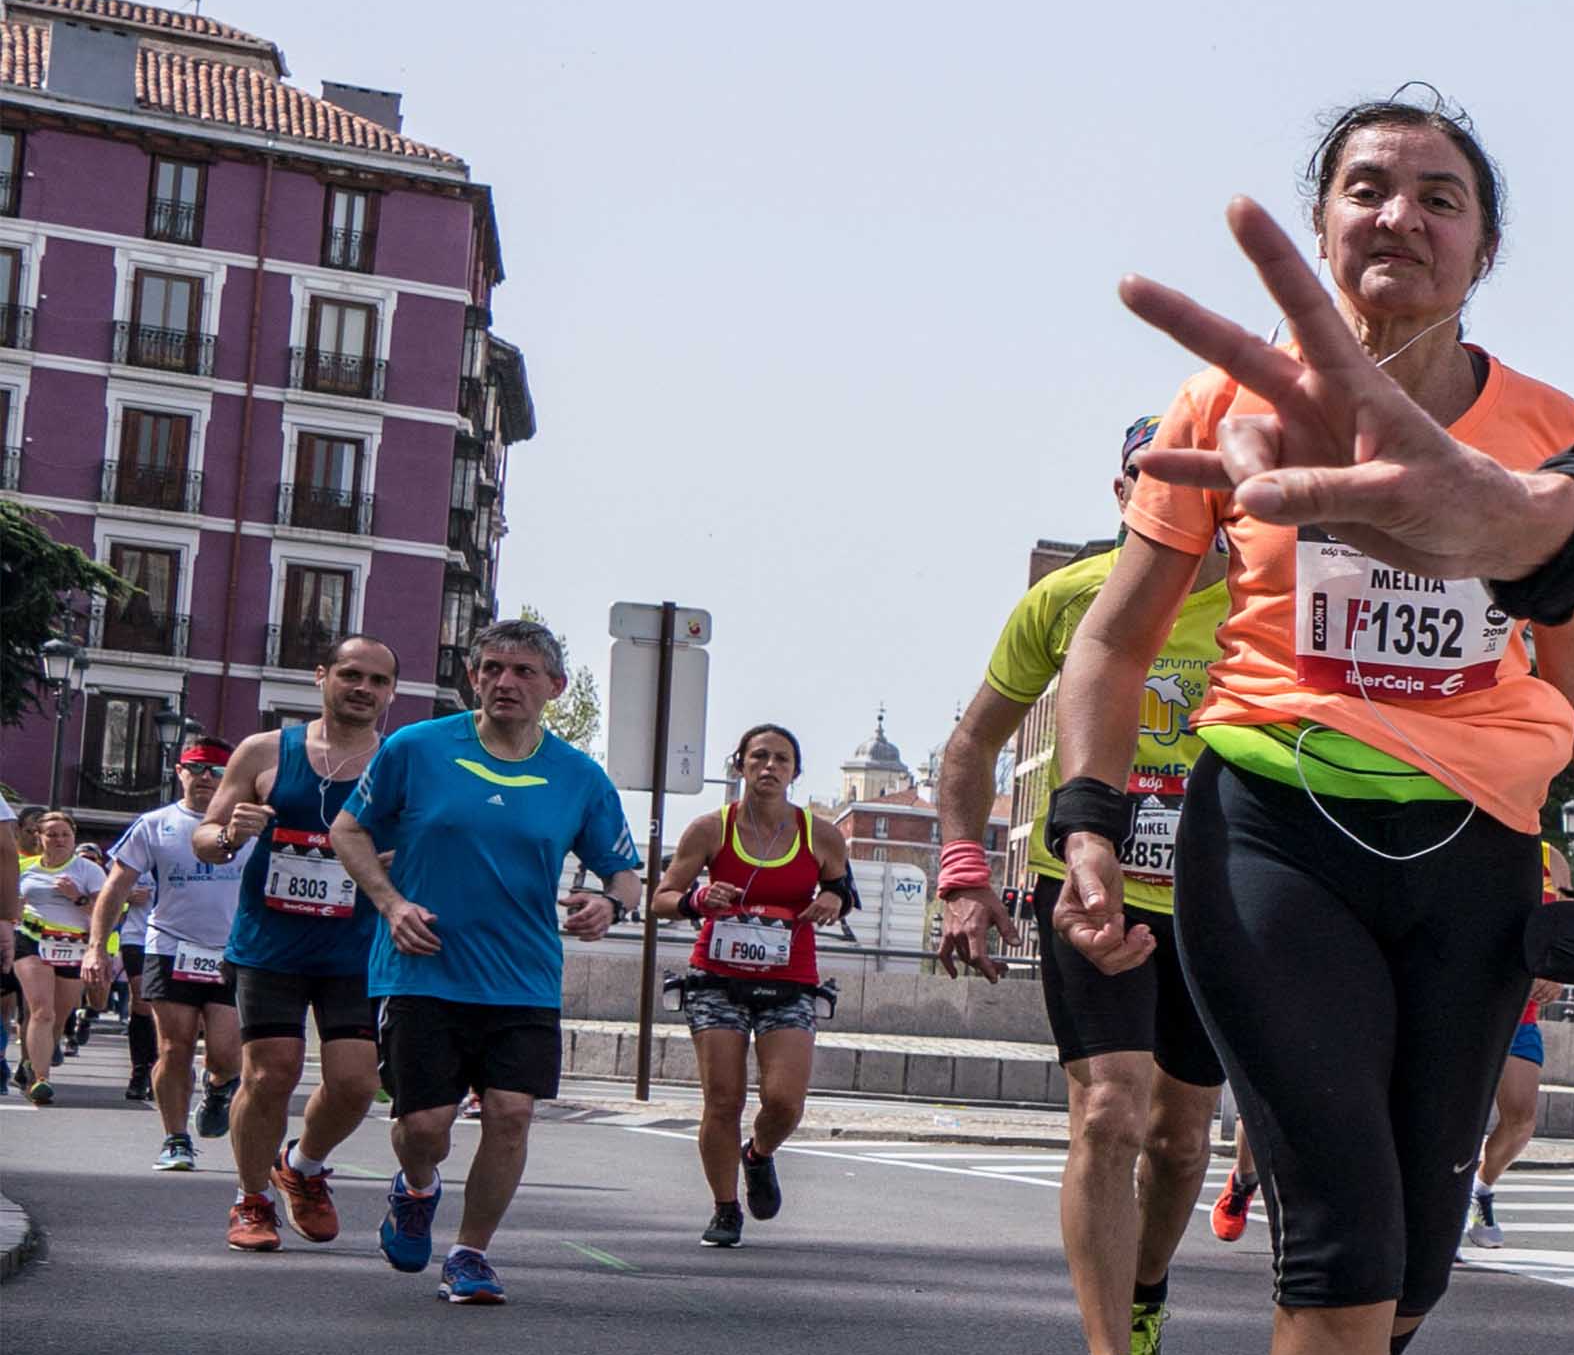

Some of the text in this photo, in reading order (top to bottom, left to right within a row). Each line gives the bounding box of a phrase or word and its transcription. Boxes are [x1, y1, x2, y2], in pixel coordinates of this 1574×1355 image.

[1315, 607, 1324, 643] CAJÓN
[1344, 598, 1465, 659] F1352
[1346, 670, 1425, 693] iberCaja
[1138, 775, 1163, 792] edp
[288, 876, 328, 900] 8303
[895, 882, 921, 894] API
[731, 941, 766, 961] F900
